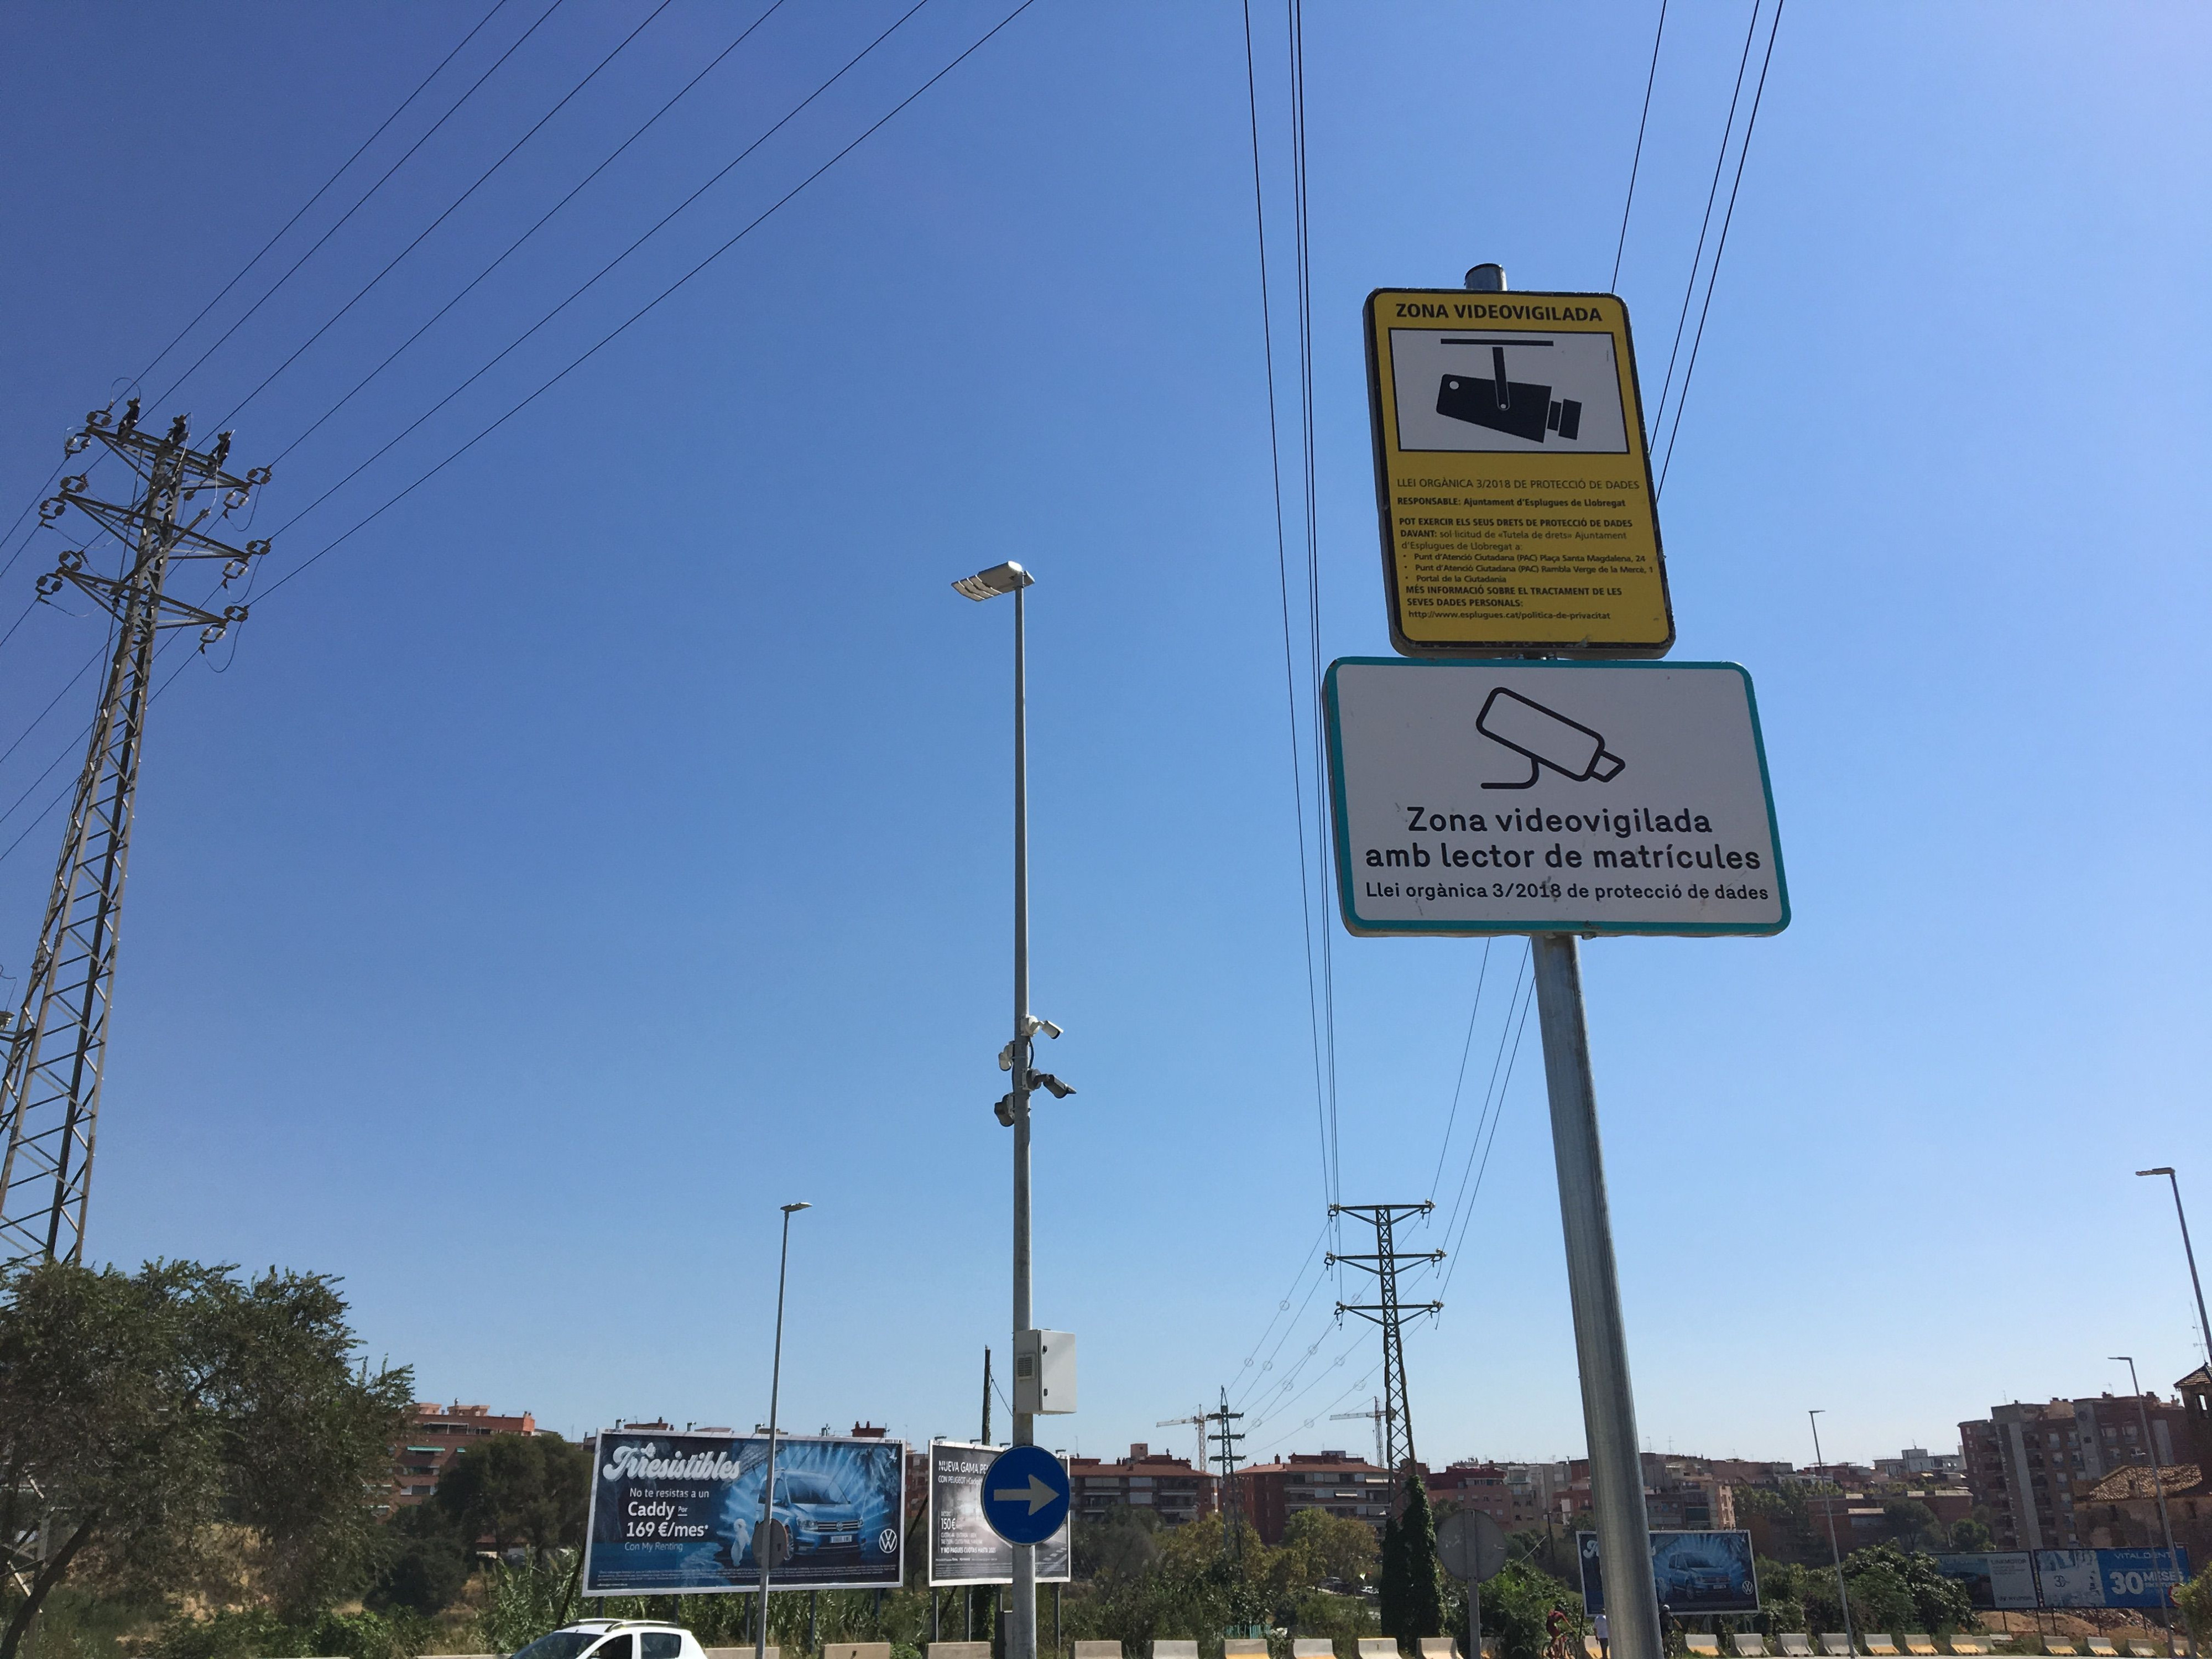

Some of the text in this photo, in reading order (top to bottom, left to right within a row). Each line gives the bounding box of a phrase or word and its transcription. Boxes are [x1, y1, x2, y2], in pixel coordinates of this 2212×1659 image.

[1395, 302, 1603, 322] ZONA VIDEOVIGILADA
[1397, 477, 1640, 490] LLEI ORGÀNICA 3/2018 DE PROTECCIÓ DE DADES
[1397, 497, 1461, 506] RESPONSABLE:
[1463, 498, 1515, 508] Ajuntament
[1571, 499, 1582, 507] de
[1584, 499, 1626, 509] Llobregat
[1418, 518, 1453, 526] EXERCIR
[1473, 518, 1494, 526] SEUS
[1496, 518, 1524, 526] DRETS
[1526, 519, 1537, 527] DE
[1540, 518, 1587, 527] PROTECCIÓ
[1603, 519, 1633, 528] DADES
[1485, 530, 1495, 539] de
[1498, 530, 1529, 539] «Tutela
[1531, 531, 1542, 539] de
[1545, 531, 1572, 539] drets»
[1574, 531, 1627, 541] Ajuntament
[1457, 541, 1468, 550] de
[1471, 541, 1512, 552] Llobregat
[1540, 554, 1561, 564] Plaça
[1587, 555, 1634, 564] Magdalena,
[1573, 566, 1597, 575] Verge
[1406, 584, 1622, 596] MÉS INFORMACIÓ SOBRE EL TRACTAMENT DE LES
[1437, 598, 1467, 607] DADES
[1469, 599, 1524, 607] PERSONALS:
[1406, 805, 1713, 838] Zona videovigilada
[1365, 842, 1761, 870] amb lector de matrícules
[1366, 882, 1768, 901] Llei orgànica 3/2018 de protecció de dades
[602, 1445, 741, 1481] Irresistibles
[938, 1460, 959, 1473] NUEVA
[960, 1461, 979, 1474] GAMA
[948, 1476, 966, 1484] PEUGEOT
[629, 1488, 642, 1498] No
[644, 1489, 654, 1498] te
[656, 1489, 688, 1498] resistas
[628, 1501, 675, 1520] Caddy
[626, 1521, 655, 1537] 169
[624, 1541, 684, 1553] Con My Renting
[2109, 1571, 2145, 1595] 30
